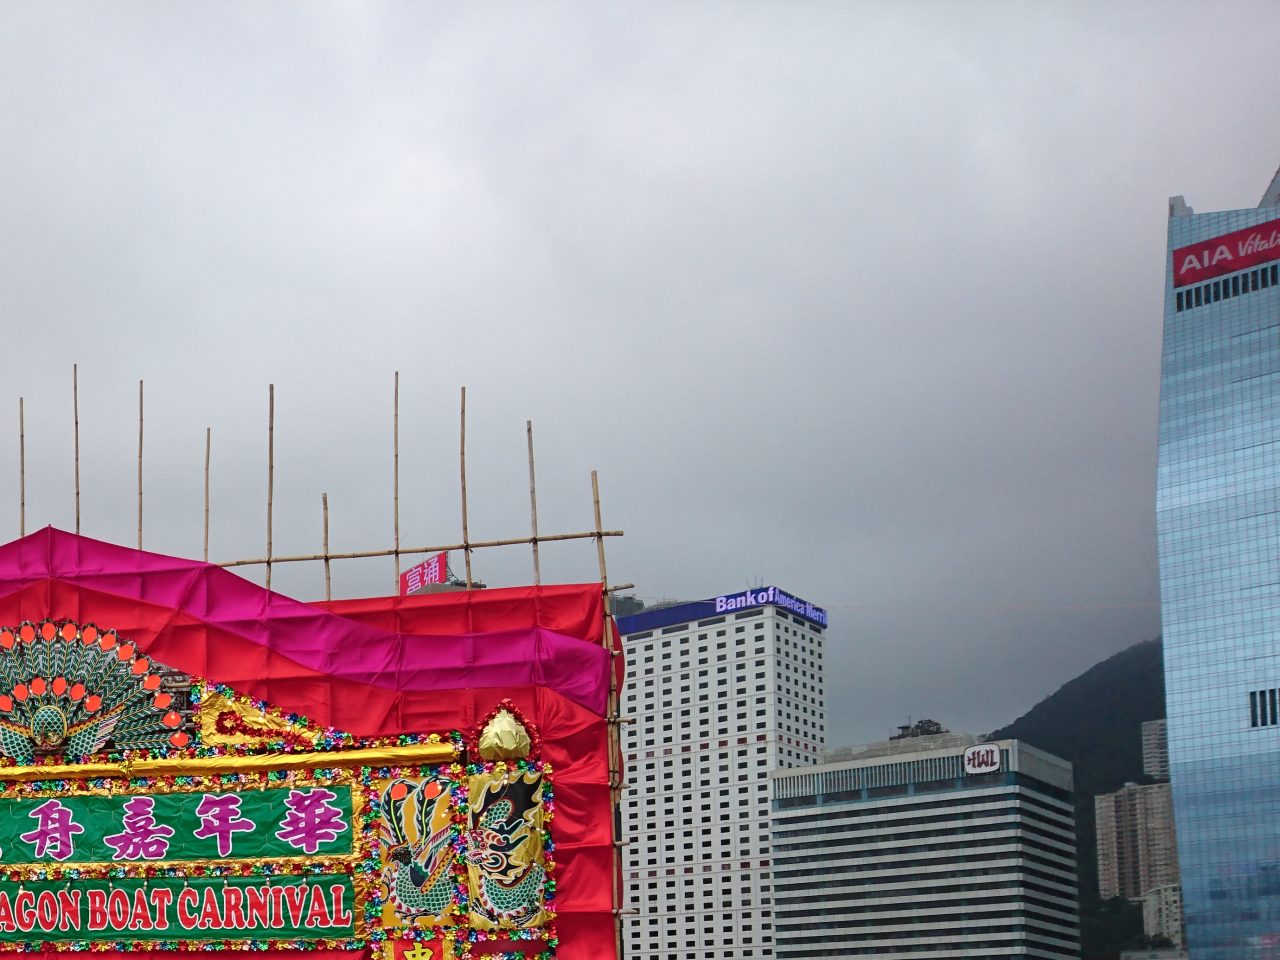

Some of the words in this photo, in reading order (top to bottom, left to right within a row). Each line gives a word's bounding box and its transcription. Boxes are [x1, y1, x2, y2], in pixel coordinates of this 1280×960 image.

[1179, 245, 1234, 275] AIA
[716, 591, 757, 613] Bank
[758, 586, 775, 603] of
[966, 749, 998, 769] HWL
[87, 888, 171, 931] BOAT
[176, 885, 353, 929] CARNIVAL
